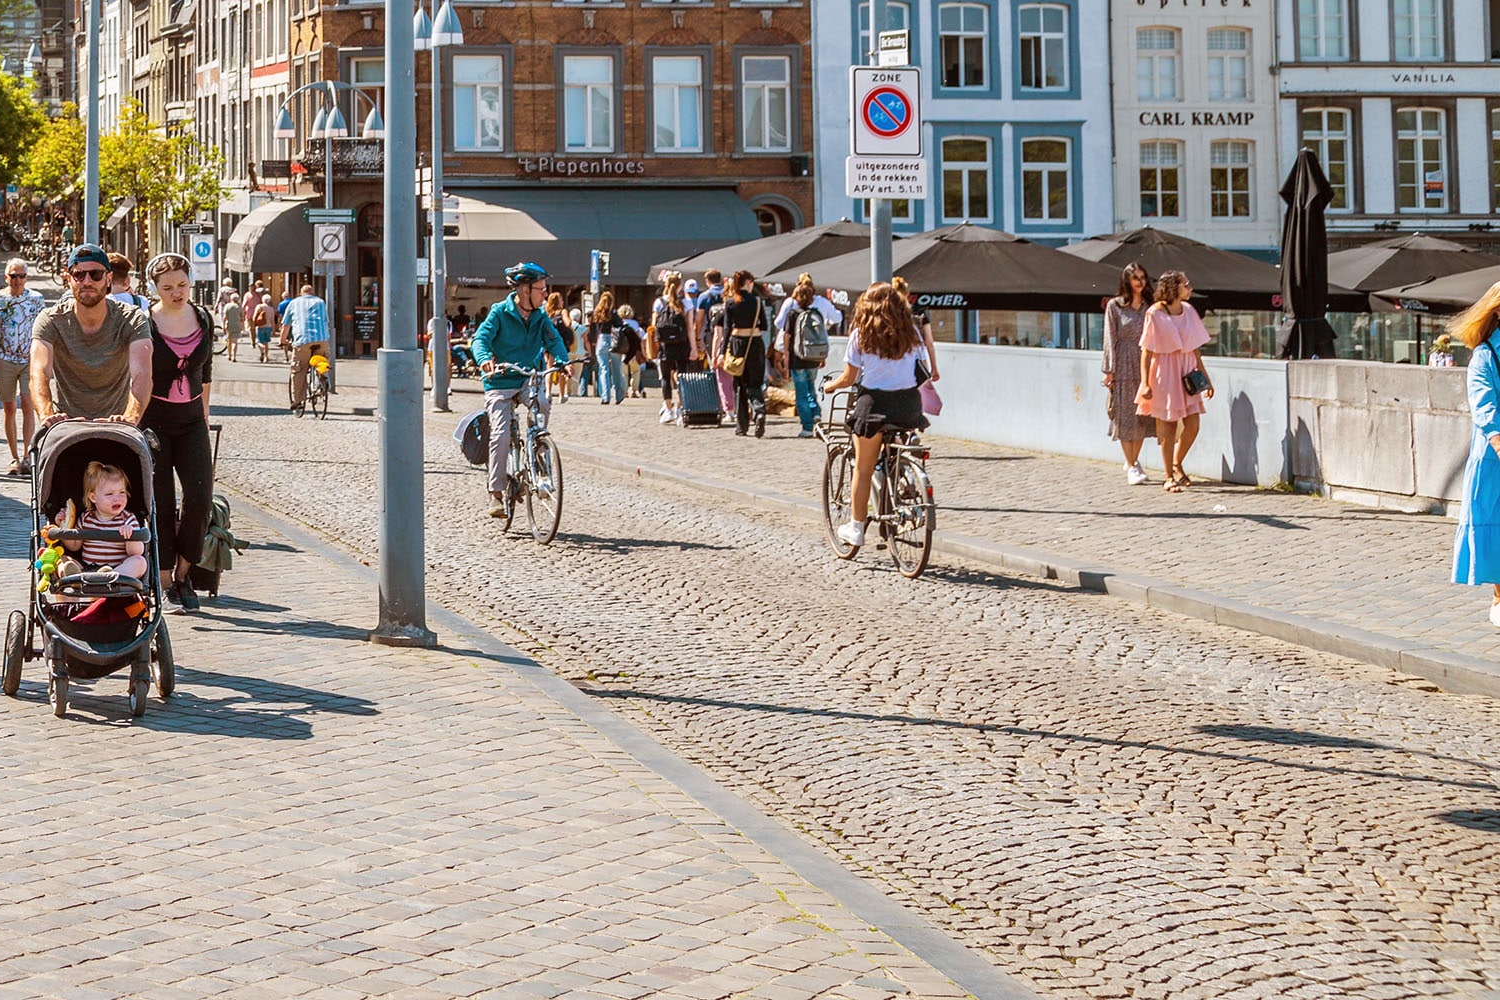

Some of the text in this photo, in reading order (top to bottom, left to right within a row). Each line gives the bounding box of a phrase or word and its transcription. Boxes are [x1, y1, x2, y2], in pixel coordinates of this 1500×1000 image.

[871, 74, 902, 82] ZONE
[1392, 74, 1455, 83] VANILIA
[1139, 111, 1255, 126] CARL KRAMP
[539, 157, 645, 176] Piepenhoes
[855, 162, 920, 172] uitgezonderd
[858, 174, 918, 182] in de rekken
[853, 185, 875, 193] APV
[877, 185, 895, 193] art.
